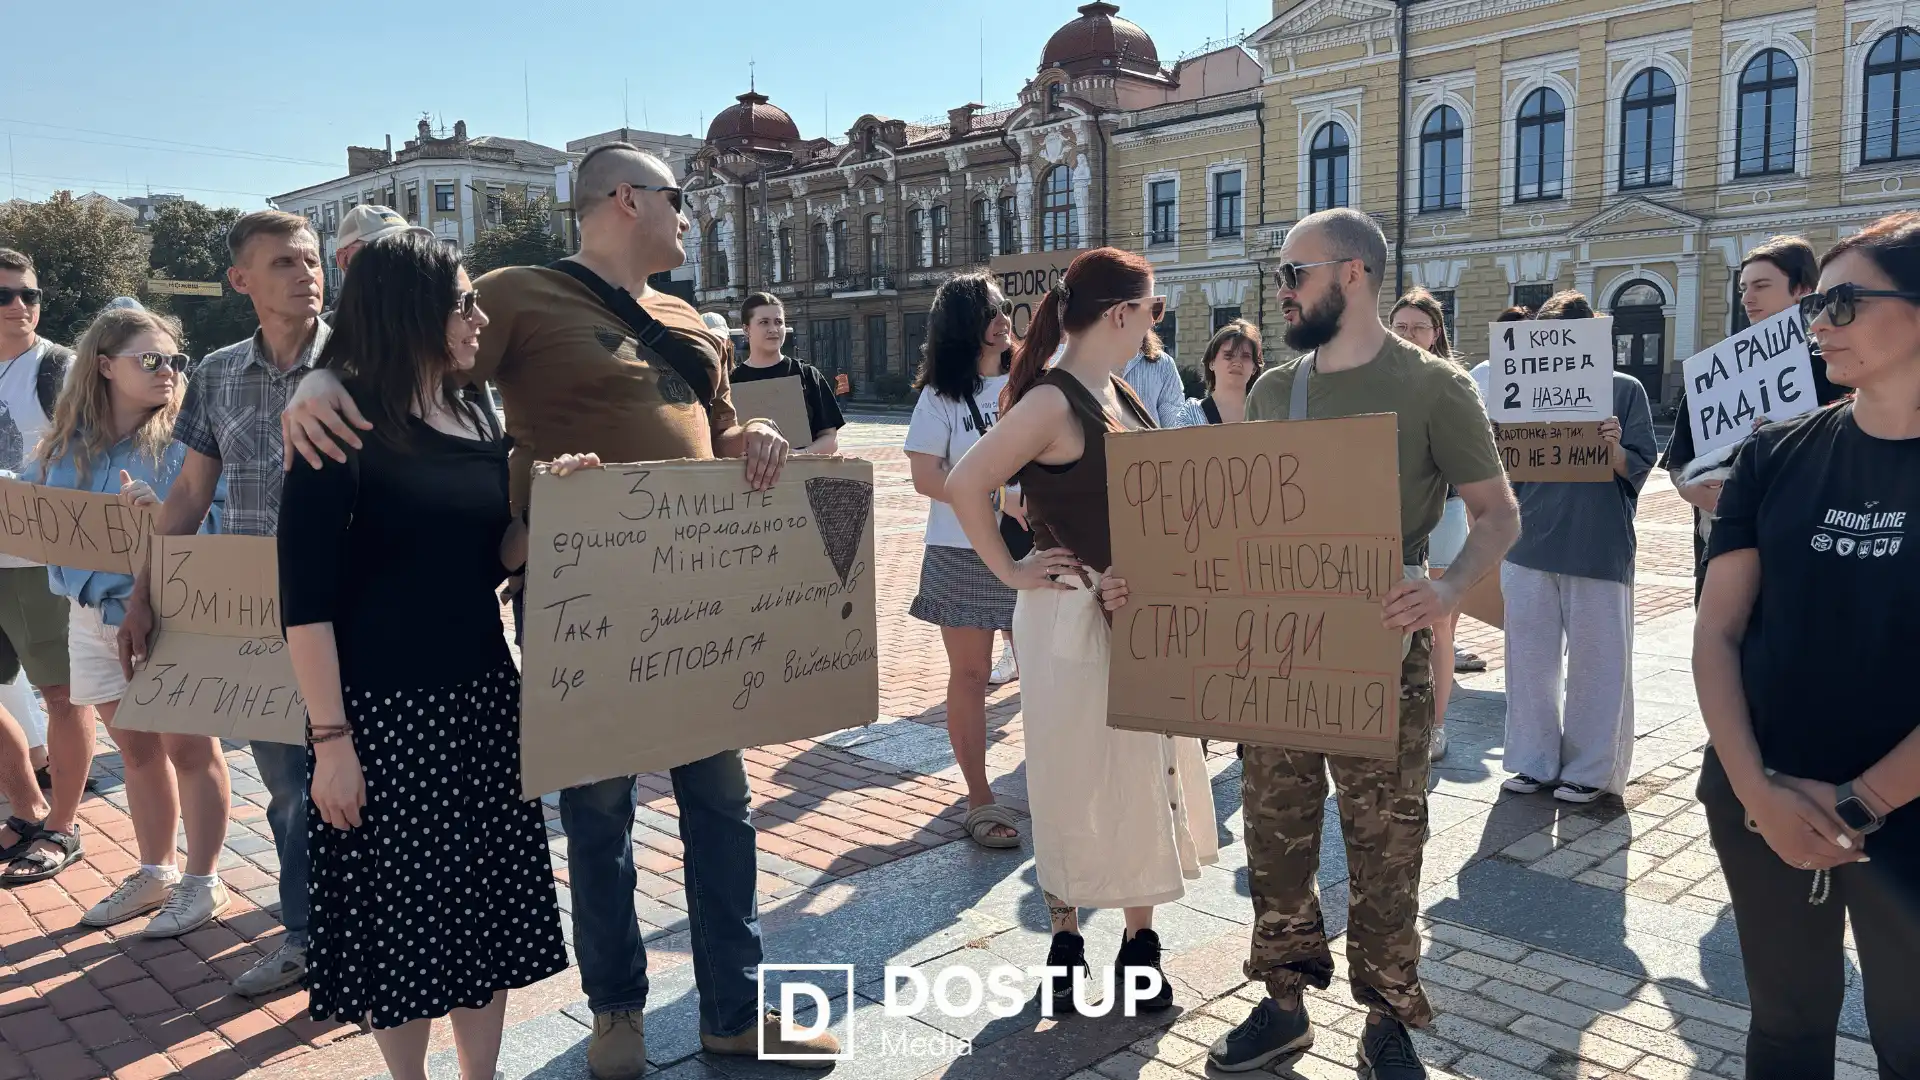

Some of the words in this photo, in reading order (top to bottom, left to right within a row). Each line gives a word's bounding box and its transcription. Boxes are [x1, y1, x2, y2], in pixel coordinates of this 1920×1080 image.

[1503, 328, 1516, 351] 1
[1530, 329, 1577, 348] КРОК
[1504, 382, 1522, 410] 2
[1532, 387, 1592, 409] НАЗАД
[1498, 427, 1547, 442] КАРТОНКА
[1550, 427, 1562, 439] ЗА
[1529, 447, 1546, 468] НЕ
[1567, 444, 1609, 466] НАМИ
[674, 515, 808, 545] нормального
[1824, 508, 1871, 531] DRONE
[1872, 511, 1907, 529] LINE
[1194, 557, 1230, 594] ЦЕ
[640, 600, 724, 643] зміна
[238, 635, 285, 656] або
[1235, 604, 1326, 679] діди
[629, 632, 767, 683] НЕПОВАГА
[732, 670, 765, 710] до
[784, 628, 877, 684] військових
[1200, 671, 1385, 734] СТАГНАЦІЯ
